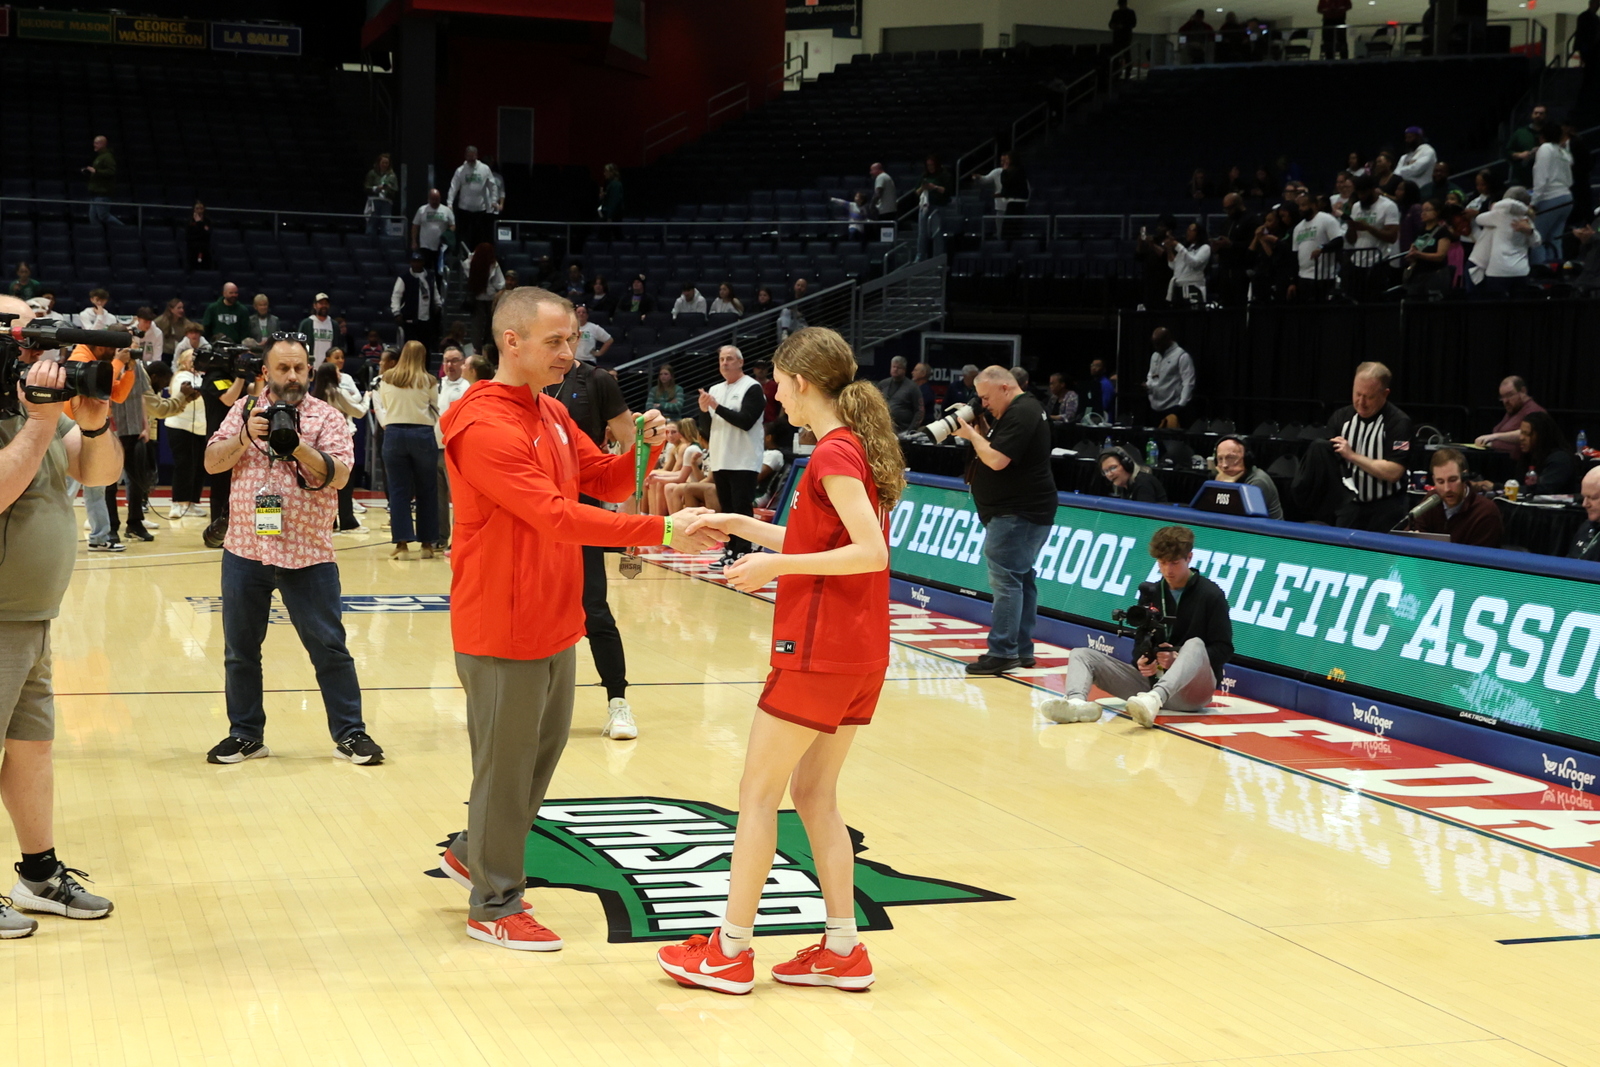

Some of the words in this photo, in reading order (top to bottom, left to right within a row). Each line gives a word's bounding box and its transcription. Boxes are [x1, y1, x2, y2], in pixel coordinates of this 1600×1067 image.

[20, 19, 65, 30] GEORGE
[69, 21, 110, 32] MASON
[134, 20, 186, 33] GEORGE
[119, 30, 203, 45] WASHINGTON
[224, 31, 243, 44] LA
[247, 33, 290, 47] SALLE
[1215, 493, 1230, 505] POSS
[907, 504, 987, 565] HIGH
[1032, 525, 1137, 596] HOOL
[1400, 588, 1600, 699] ASSO
[1363, 705, 1394, 735] Kroger
[1459, 711, 1497, 726] DAKTRONICS
[1557, 757, 1596, 790] Kroger
